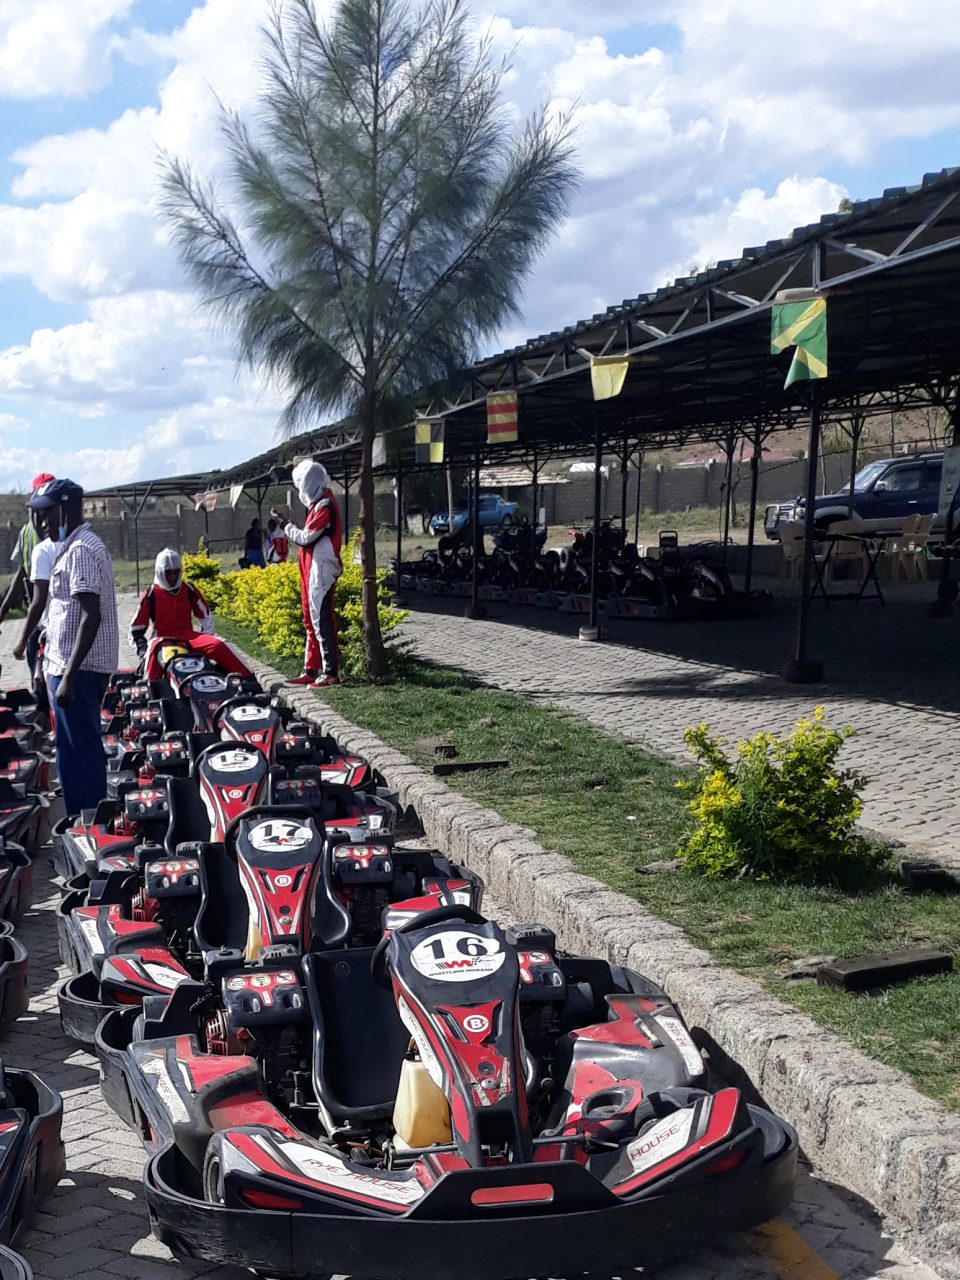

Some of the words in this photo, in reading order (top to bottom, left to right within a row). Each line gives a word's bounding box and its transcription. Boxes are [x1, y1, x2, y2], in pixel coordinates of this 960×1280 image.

[217, 753, 250, 763] 15
[259, 824, 301, 837] 17
[423, 936, 489, 960] 16
[630, 1124, 680, 1160] HOUSE
[302, 1158, 344, 1173] RYE
[343, 1172, 418, 1193] HOUSE
